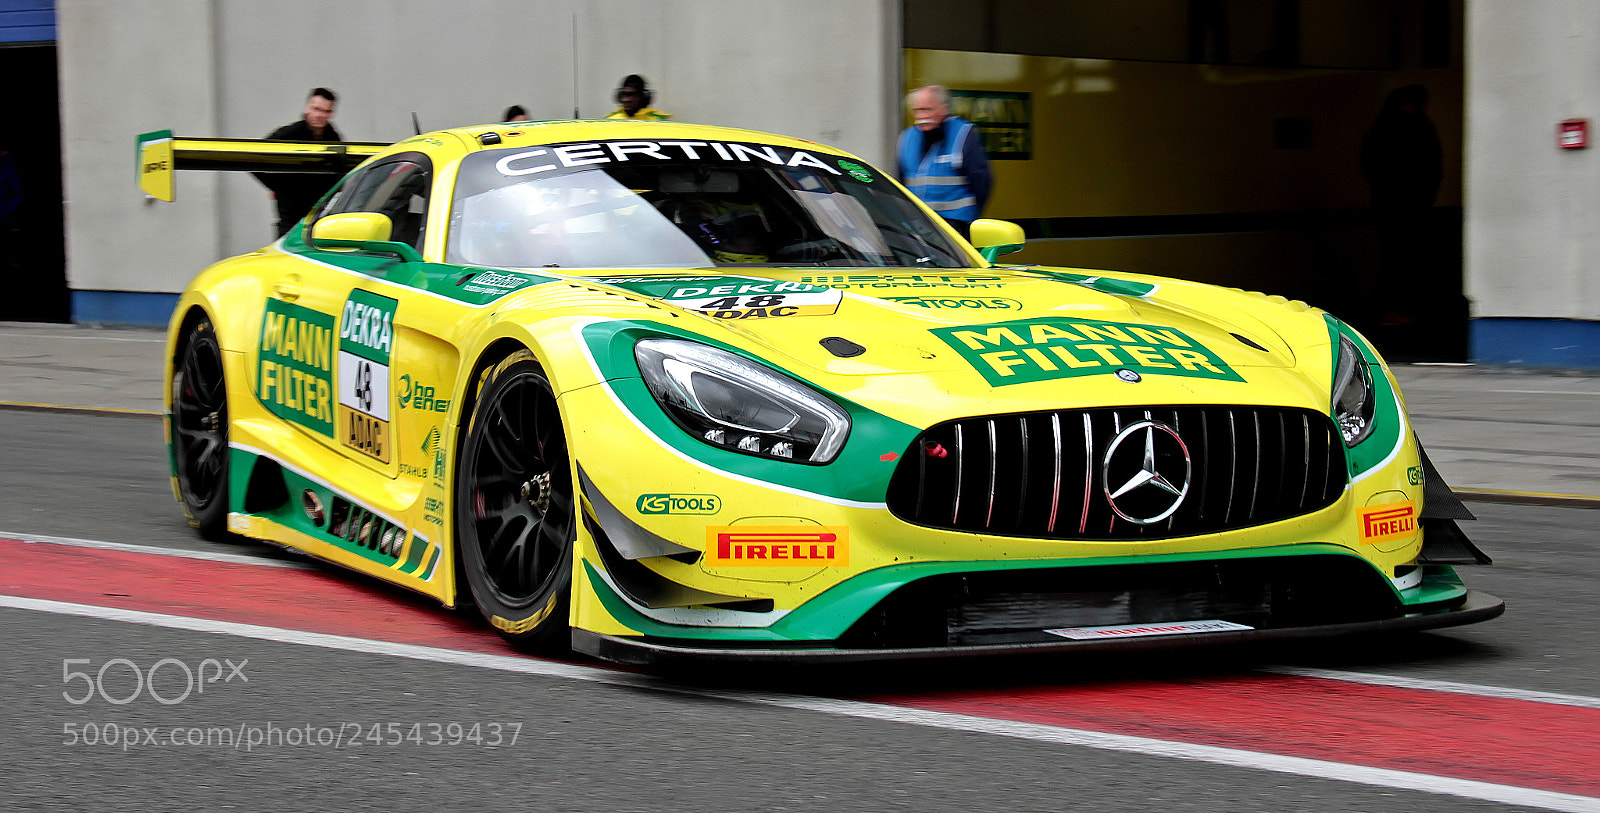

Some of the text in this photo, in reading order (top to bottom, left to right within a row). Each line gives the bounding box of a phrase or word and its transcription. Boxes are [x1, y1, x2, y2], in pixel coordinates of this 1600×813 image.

[495, 141, 843, 176] CERTINA
[699, 294, 787, 311] 48
[262, 311, 332, 371] MANN
[339, 300, 392, 353] DEKRA
[949, 323, 1194, 350] MANN
[978, 343, 1226, 377] FILTER
[259, 360, 332, 424] FILTER
[354, 360, 373, 412] 48
[345, 412, 383, 457] ADAC
[1363, 506, 1414, 538] PIRELLI
[717, 533, 837, 559] PIRELLI
